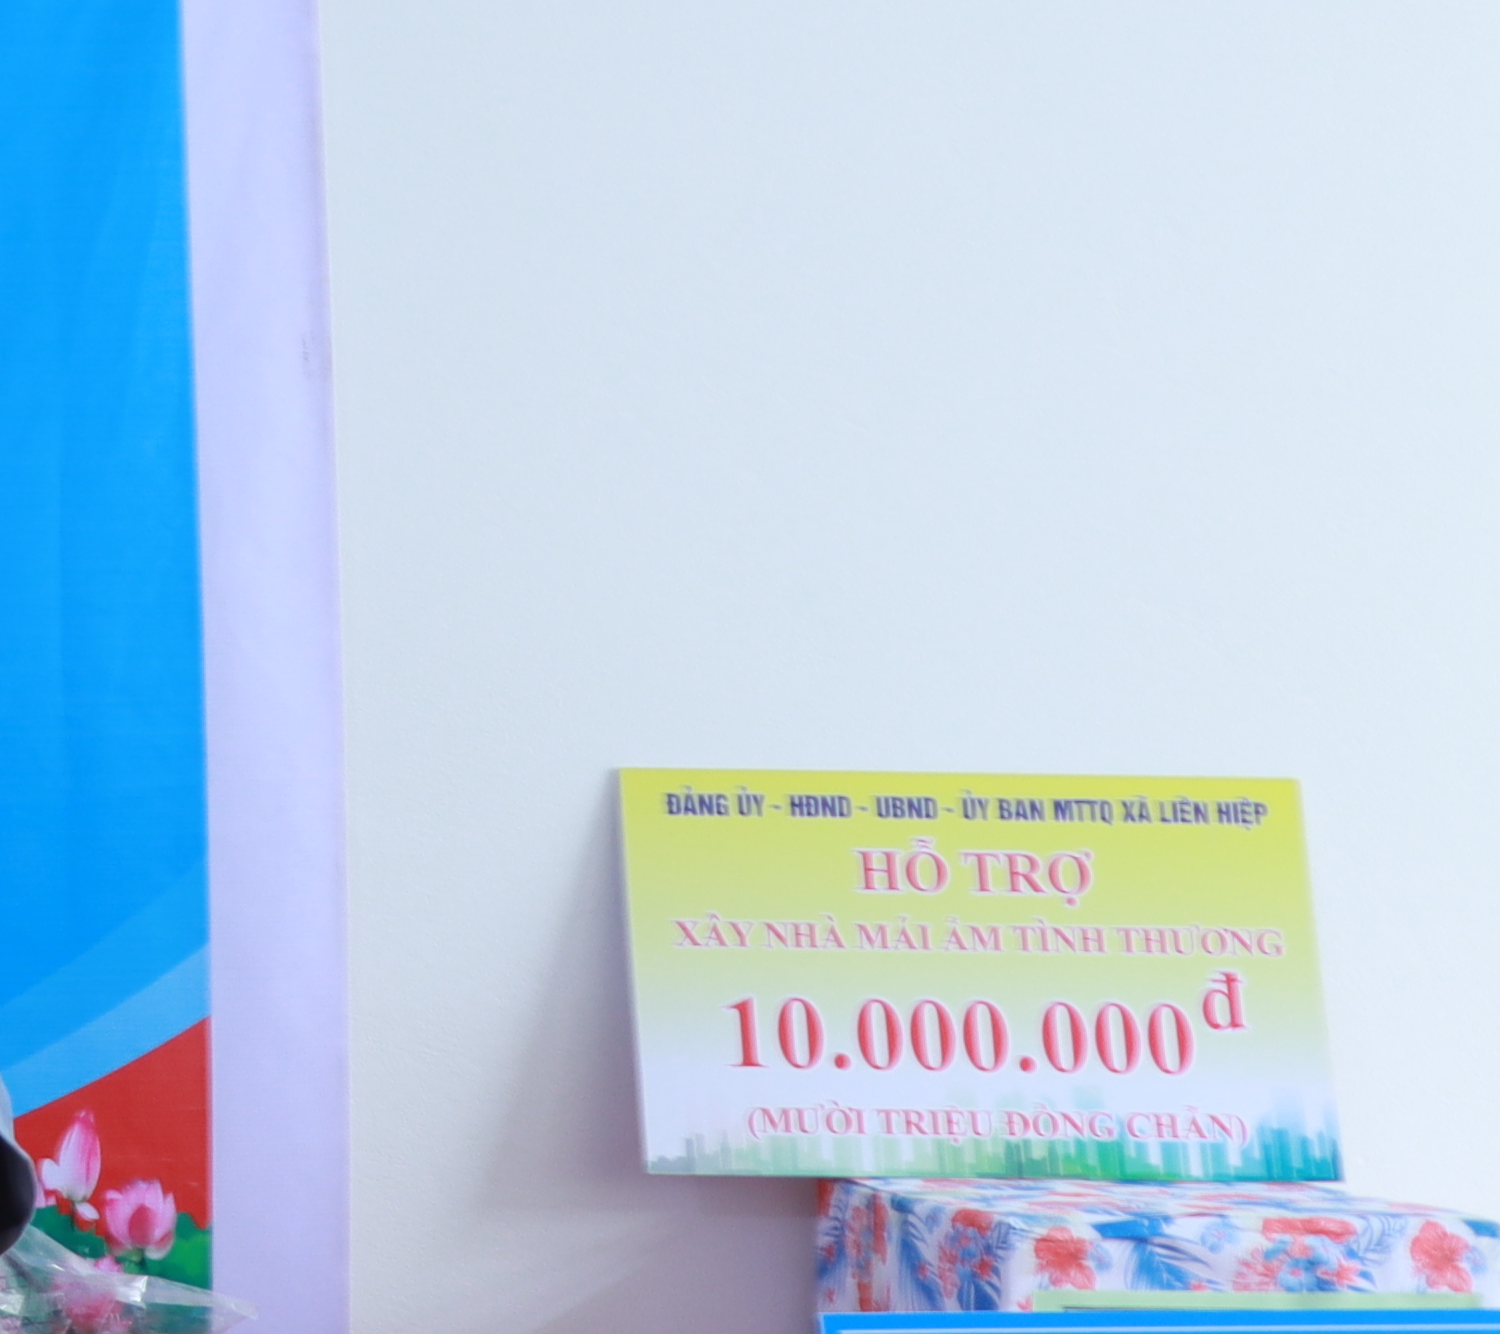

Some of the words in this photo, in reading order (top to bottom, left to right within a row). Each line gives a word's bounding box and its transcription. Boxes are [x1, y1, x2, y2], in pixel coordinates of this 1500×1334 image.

[666, 787, 730, 817] ĐẢNG
[789, 794, 852, 818] HĐND
[876, 795, 938, 819] UBND
[998, 797, 1046, 822] BAN
[1052, 798, 1114, 825] MTTQ
[1158, 796, 1210, 825] LIÊN
[1216, 797, 1269, 831] HIỆP
[854, 837, 950, 893] HỖ
[963, 850, 1094, 907] TRỢ
[673, 912, 754, 949] XÂY
[764, 913, 847, 950] NHÀ
[1013, 916, 1108, 954] TÌNH
[1115, 923, 1286, 957] THƯƠNG
[877, 1104, 994, 1142] TRIỆU
[1004, 1102, 1117, 1143] ĐỒNG
